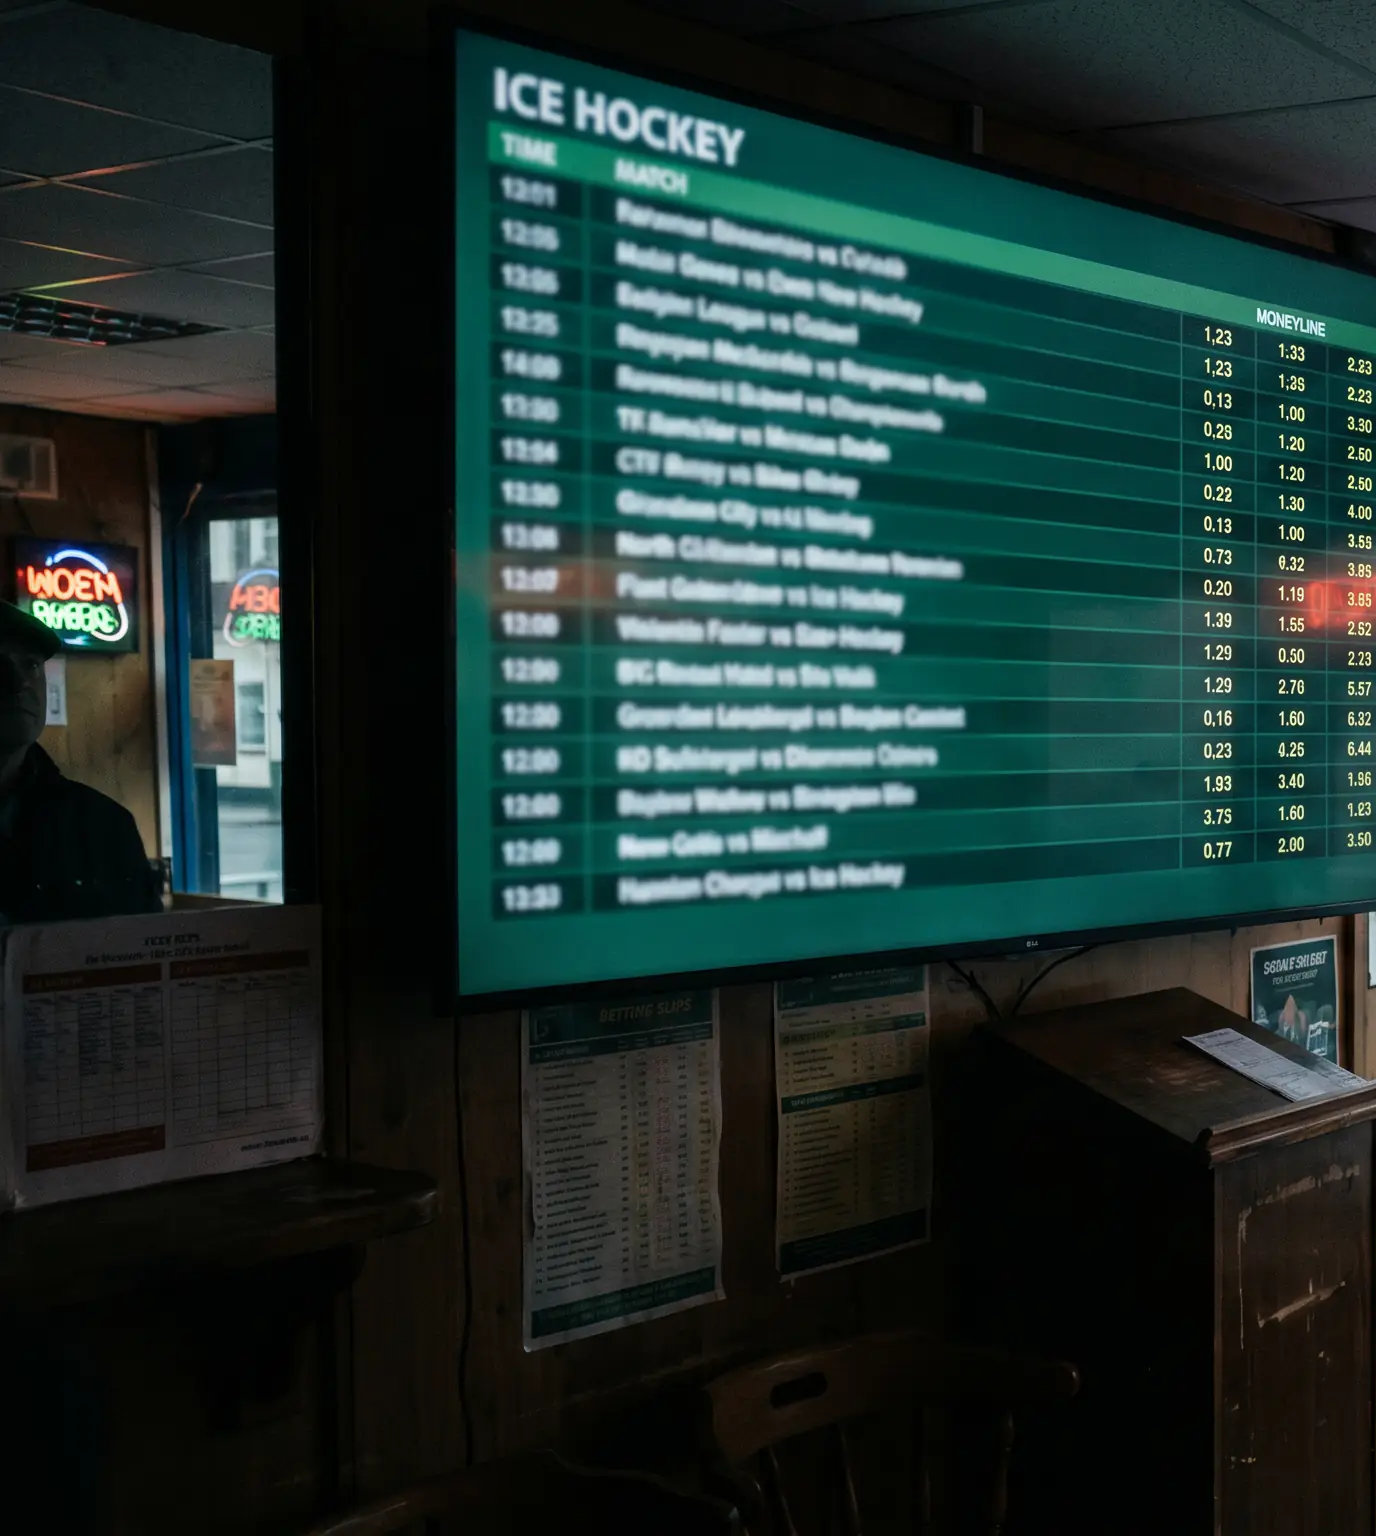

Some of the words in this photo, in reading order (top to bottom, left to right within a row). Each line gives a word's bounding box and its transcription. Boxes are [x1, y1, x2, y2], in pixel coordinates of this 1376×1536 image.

[494, 67, 565, 124] ICE
[574, 87, 745, 166] HOCKEY
[501, 132, 557, 167] TIME
[614, 158, 688, 197] MATCH
[1255, 307, 1327, 338] MONEYLINE
[1346, 386, 1373, 405] 2.23
[1346, 415, 1373, 434] 3.30
[1277, 433, 1305, 452] 1.20
[1346, 445, 1373, 463] 2.50
[1277, 464, 1305, 482] 1.20
[1346, 474, 1373, 492] 2.50
[1277, 494, 1305, 512] 1.30
[1346, 504, 1373, 521] 4.00
[1203, 515, 1233, 534] 0.13
[1277, 524, 1305, 542] 1.00
[1203, 547, 1233, 565] 0.73
[1203, 579, 1233, 597] 0.20
[1277, 585, 1305, 603] 1.19
[1203, 611, 1233, 629] 1.39
[1203, 643, 1233, 661] 1.29
[1277, 647, 1305, 664] 0.50
[1346, 650, 1373, 667] 2.23
[1203, 676, 1233, 694] 1.29
[1346, 680, 1373, 697] 5.57
[1277, 710, 1305, 727] 1.60
[1346, 711, 1373, 727] 6.32
[1346, 740, 1373, 757] 6.44
[1203, 775, 1233, 793] 1.93
[1277, 772, 1305, 789] 3.40
[1277, 804, 1305, 821] 1.60
[1346, 831, 1373, 848] 3.50
[1203, 841, 1233, 859] 0.77
[599, 1003, 653, 1024] BETTING
[656, 998, 693, 1015] SLIPS
